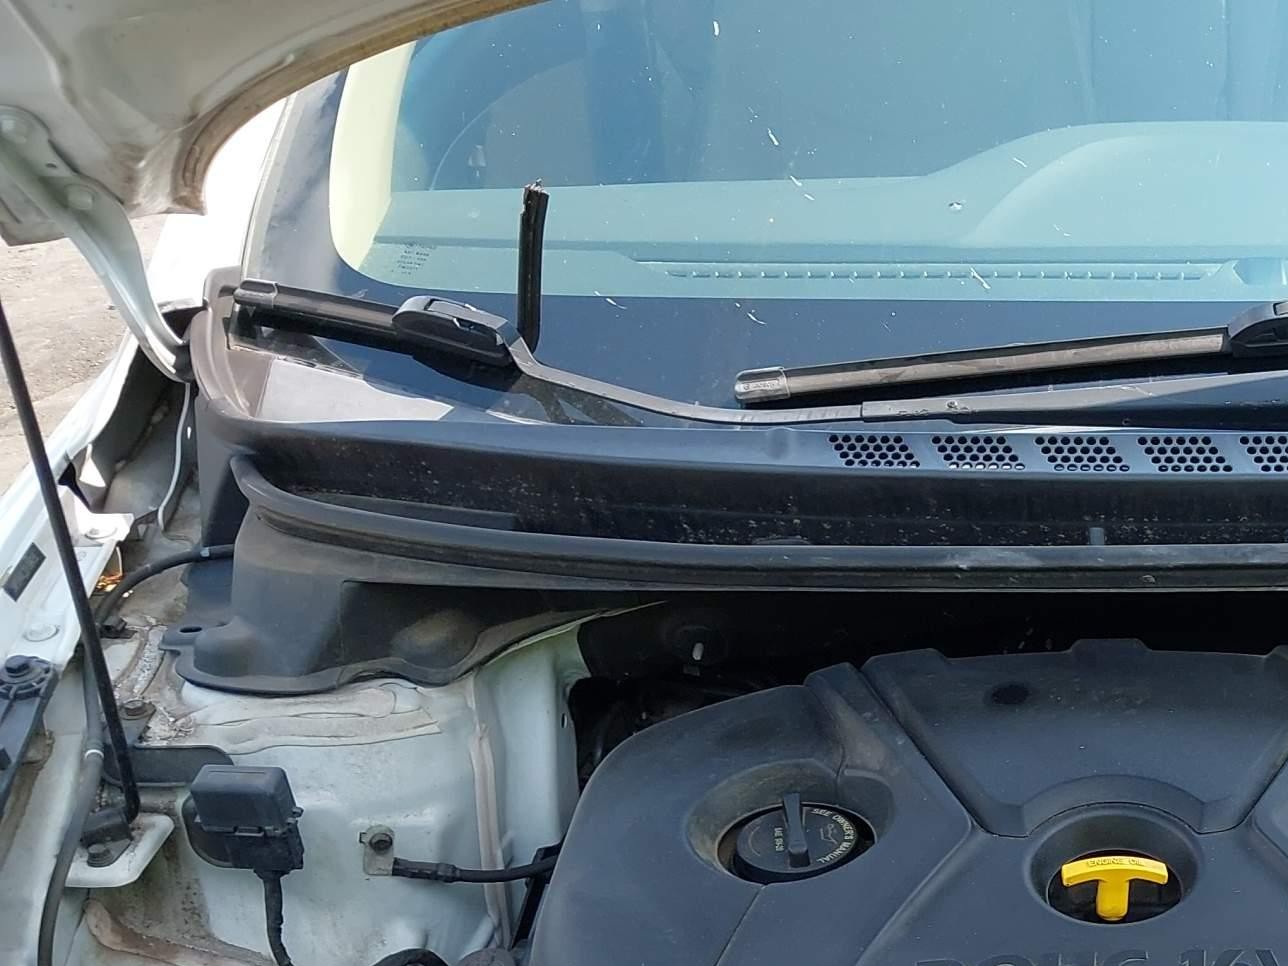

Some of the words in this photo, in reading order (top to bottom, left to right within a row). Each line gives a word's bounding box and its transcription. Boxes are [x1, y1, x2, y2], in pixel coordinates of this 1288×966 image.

[811, 807, 833, 817] SEE
[816, 841, 852, 865] MANUAL
[1086, 857, 1125, 867] ENGINE
[1127, 858, 1145, 867] OIL
